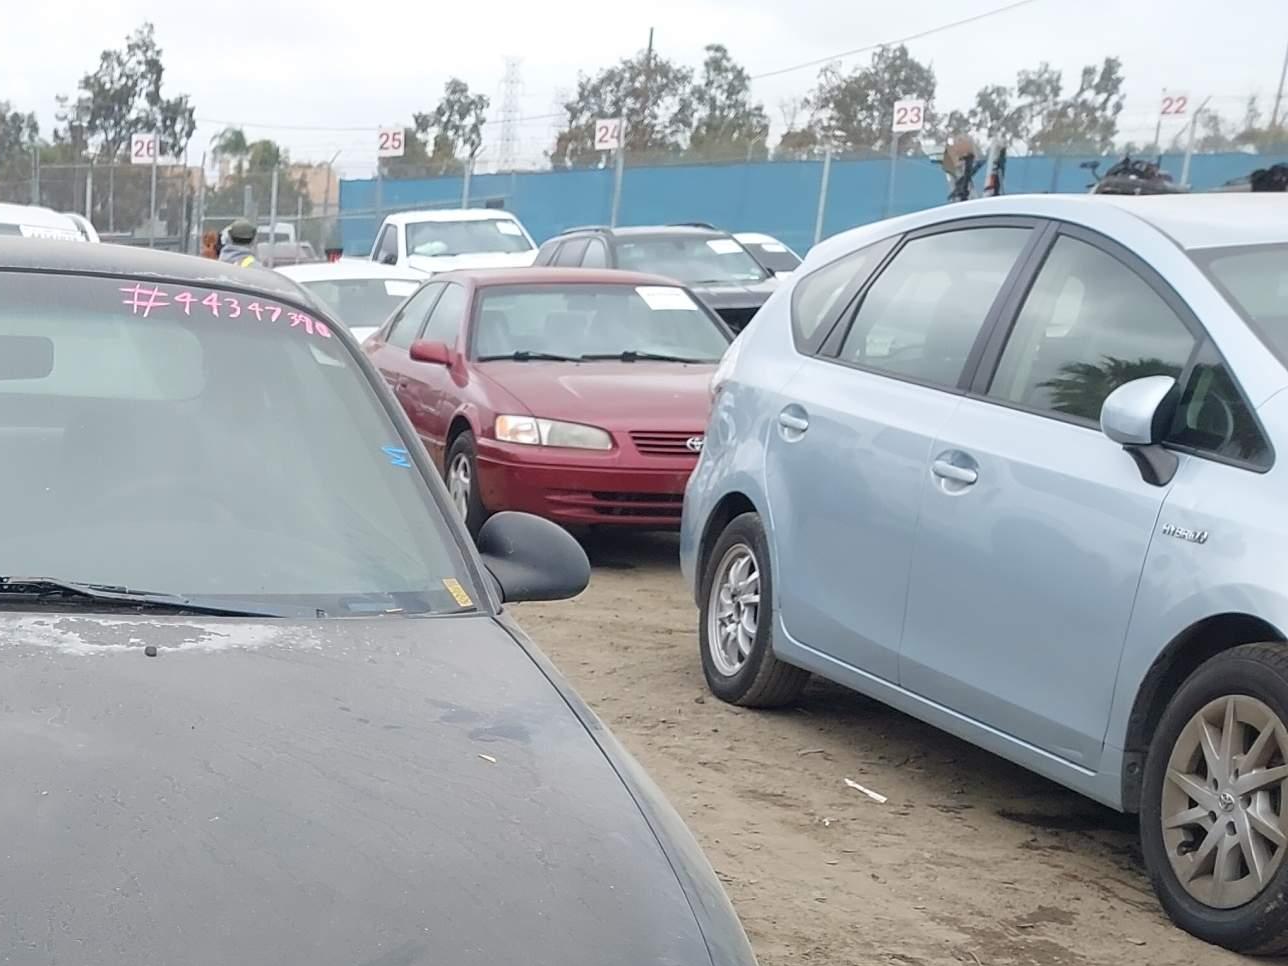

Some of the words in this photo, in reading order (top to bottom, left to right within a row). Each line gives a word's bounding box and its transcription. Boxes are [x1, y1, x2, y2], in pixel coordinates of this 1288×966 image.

[1161, 96, 1188, 115] 22
[896, 106, 921, 124] 23
[379, 131, 402, 150] 25
[599, 125, 621, 143] 24
[134, 140, 156, 157] 26
